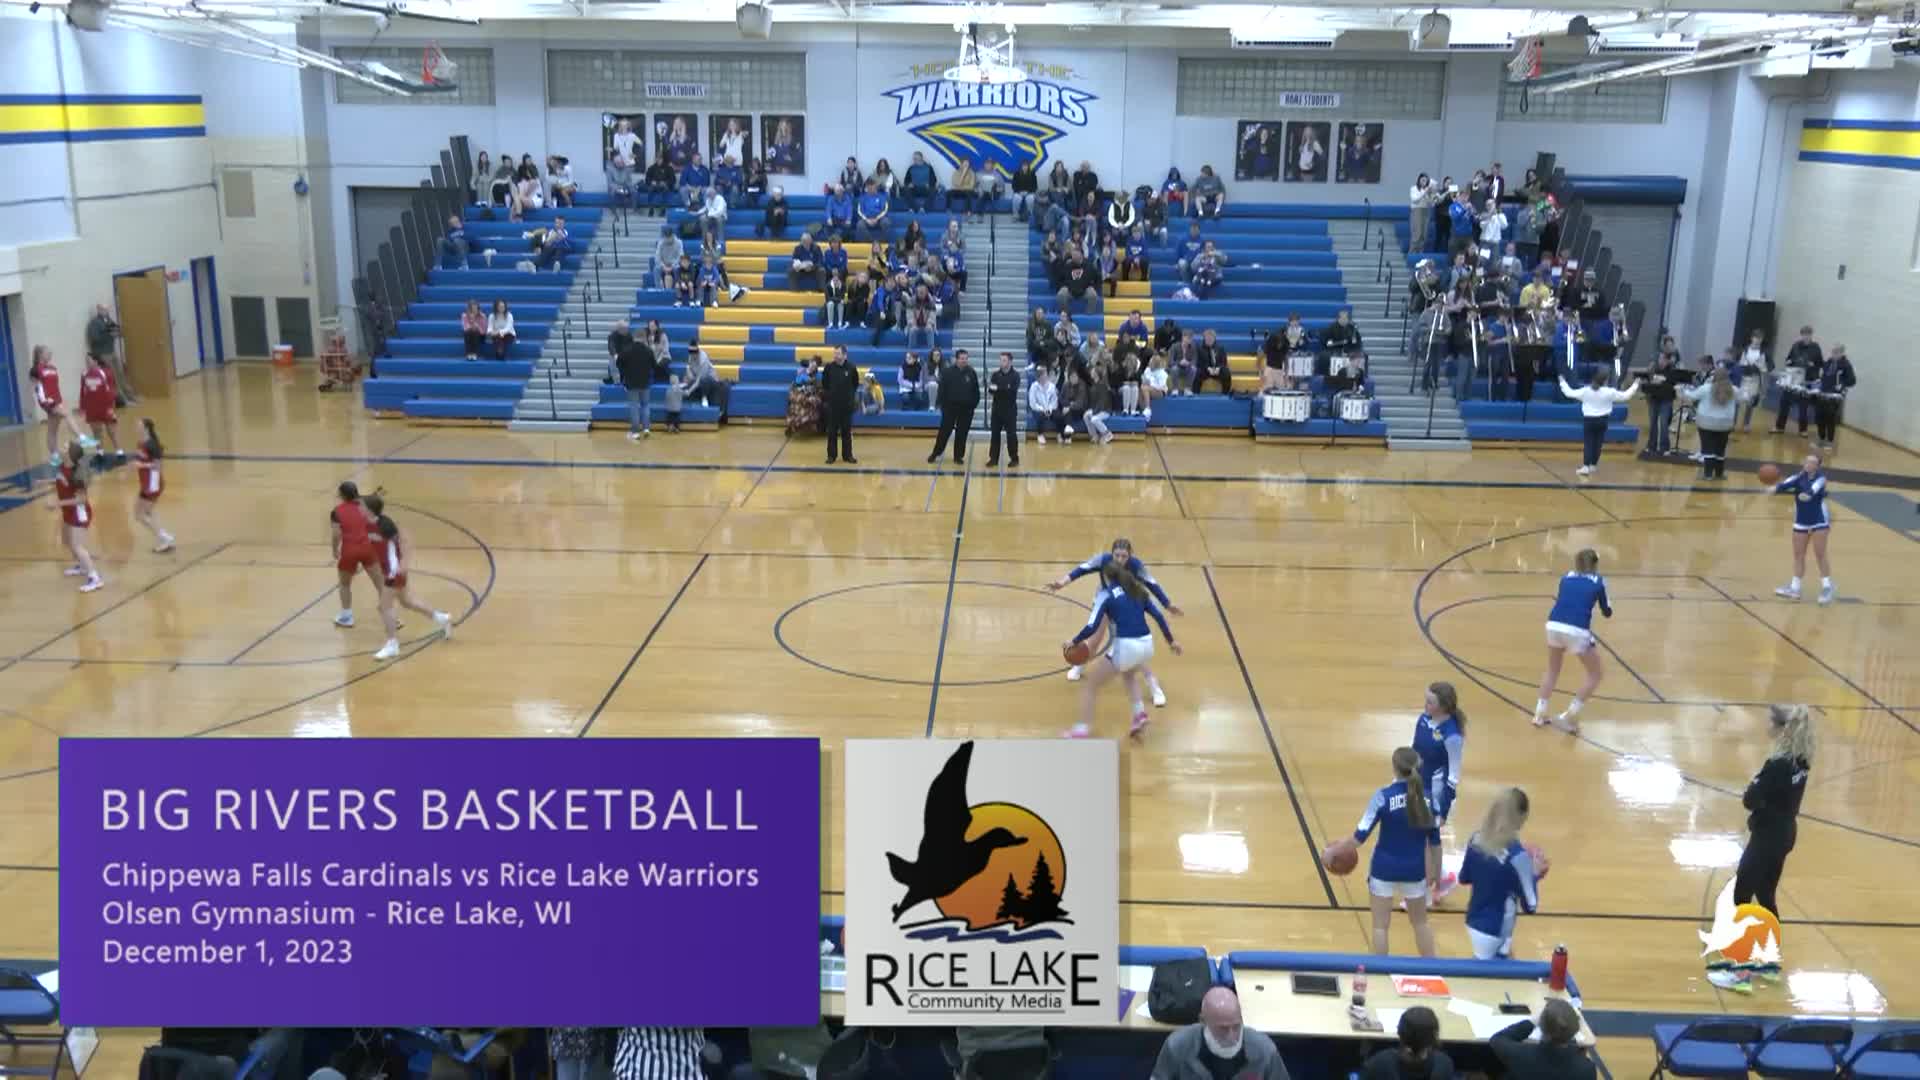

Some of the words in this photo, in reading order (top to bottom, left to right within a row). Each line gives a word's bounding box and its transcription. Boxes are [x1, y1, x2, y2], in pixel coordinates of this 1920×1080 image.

[647, 84, 672, 97] VISITOR
[673, 84, 705, 97] STUDENTS
[880, 79, 1100, 126] WARRIORS
[1284, 94, 1302, 105] HOME
[1303, 95, 1335, 106] STUDENTS
